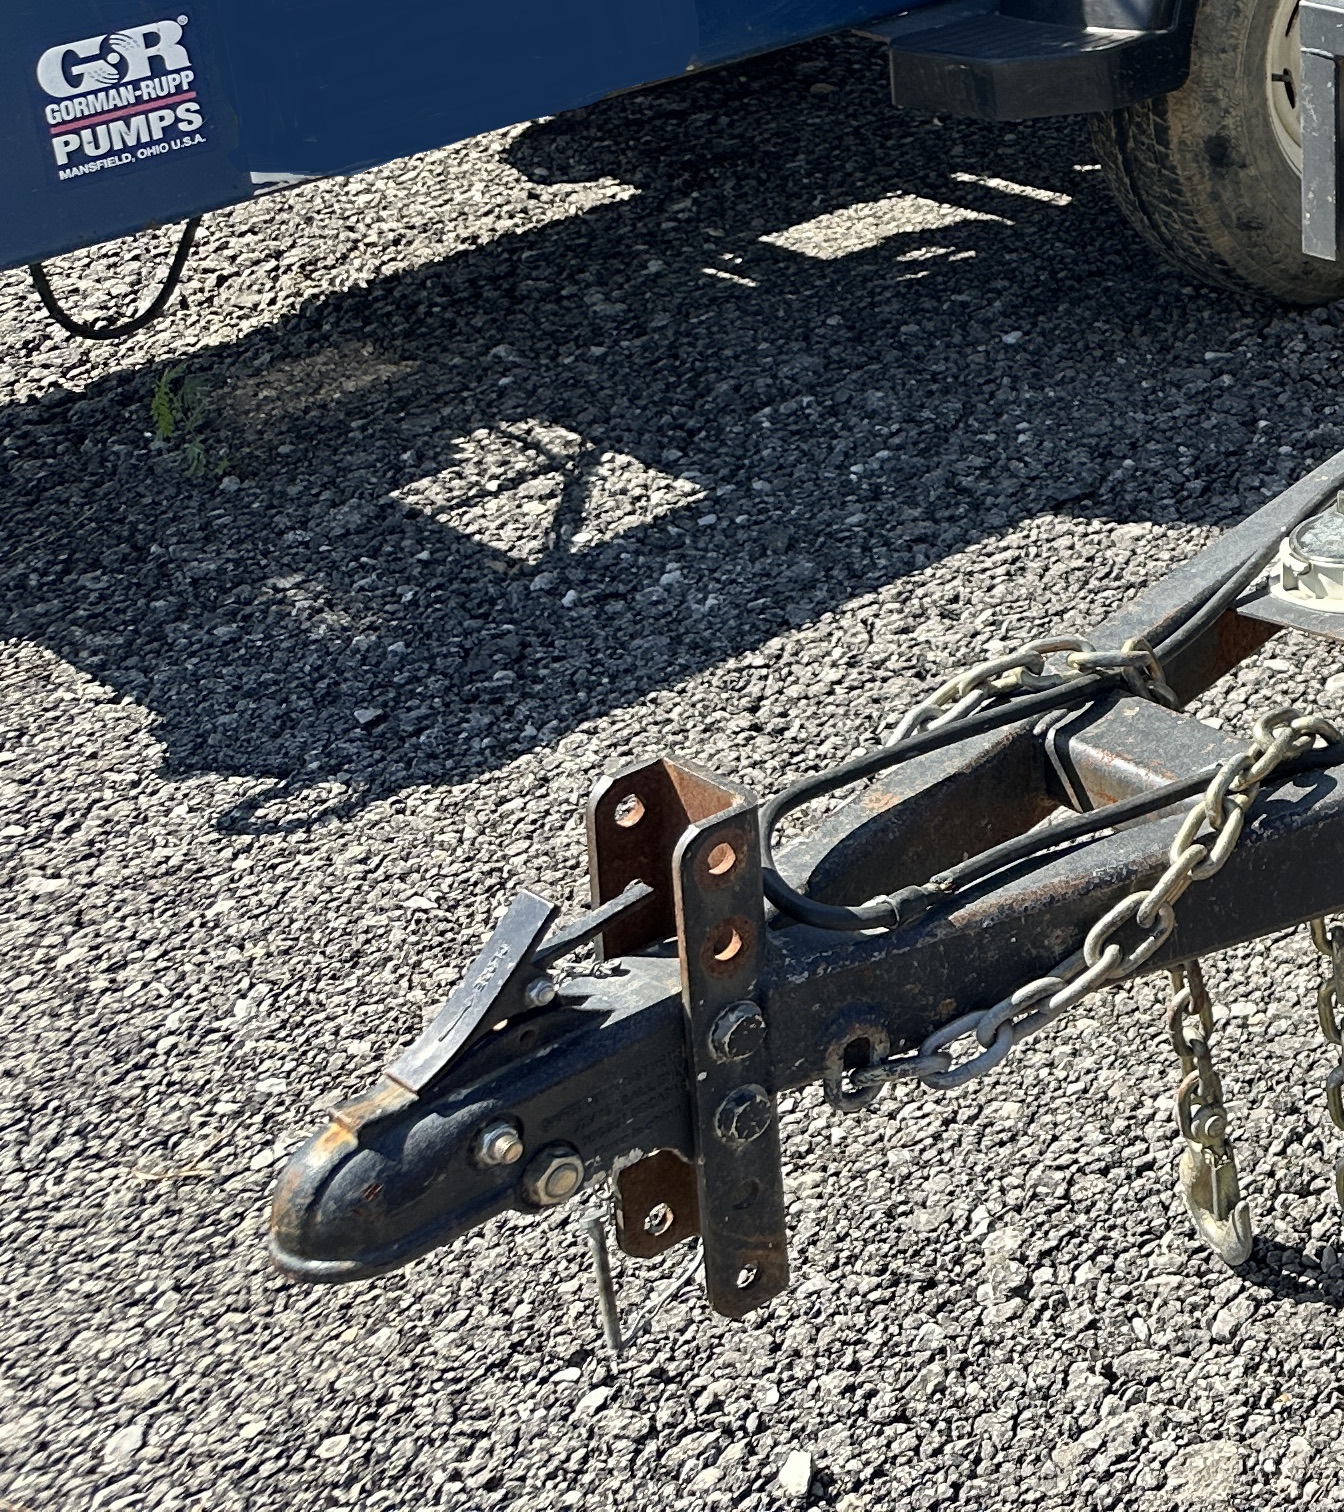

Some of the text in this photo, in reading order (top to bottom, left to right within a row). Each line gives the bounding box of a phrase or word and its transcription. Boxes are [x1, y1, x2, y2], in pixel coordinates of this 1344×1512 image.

[45, 70, 195, 125] GORMAN-RUPP
[52, 101, 203, 166] PUMPS
[58, 133, 207, 181] MANSFIELD, OHIO U.S.A.
